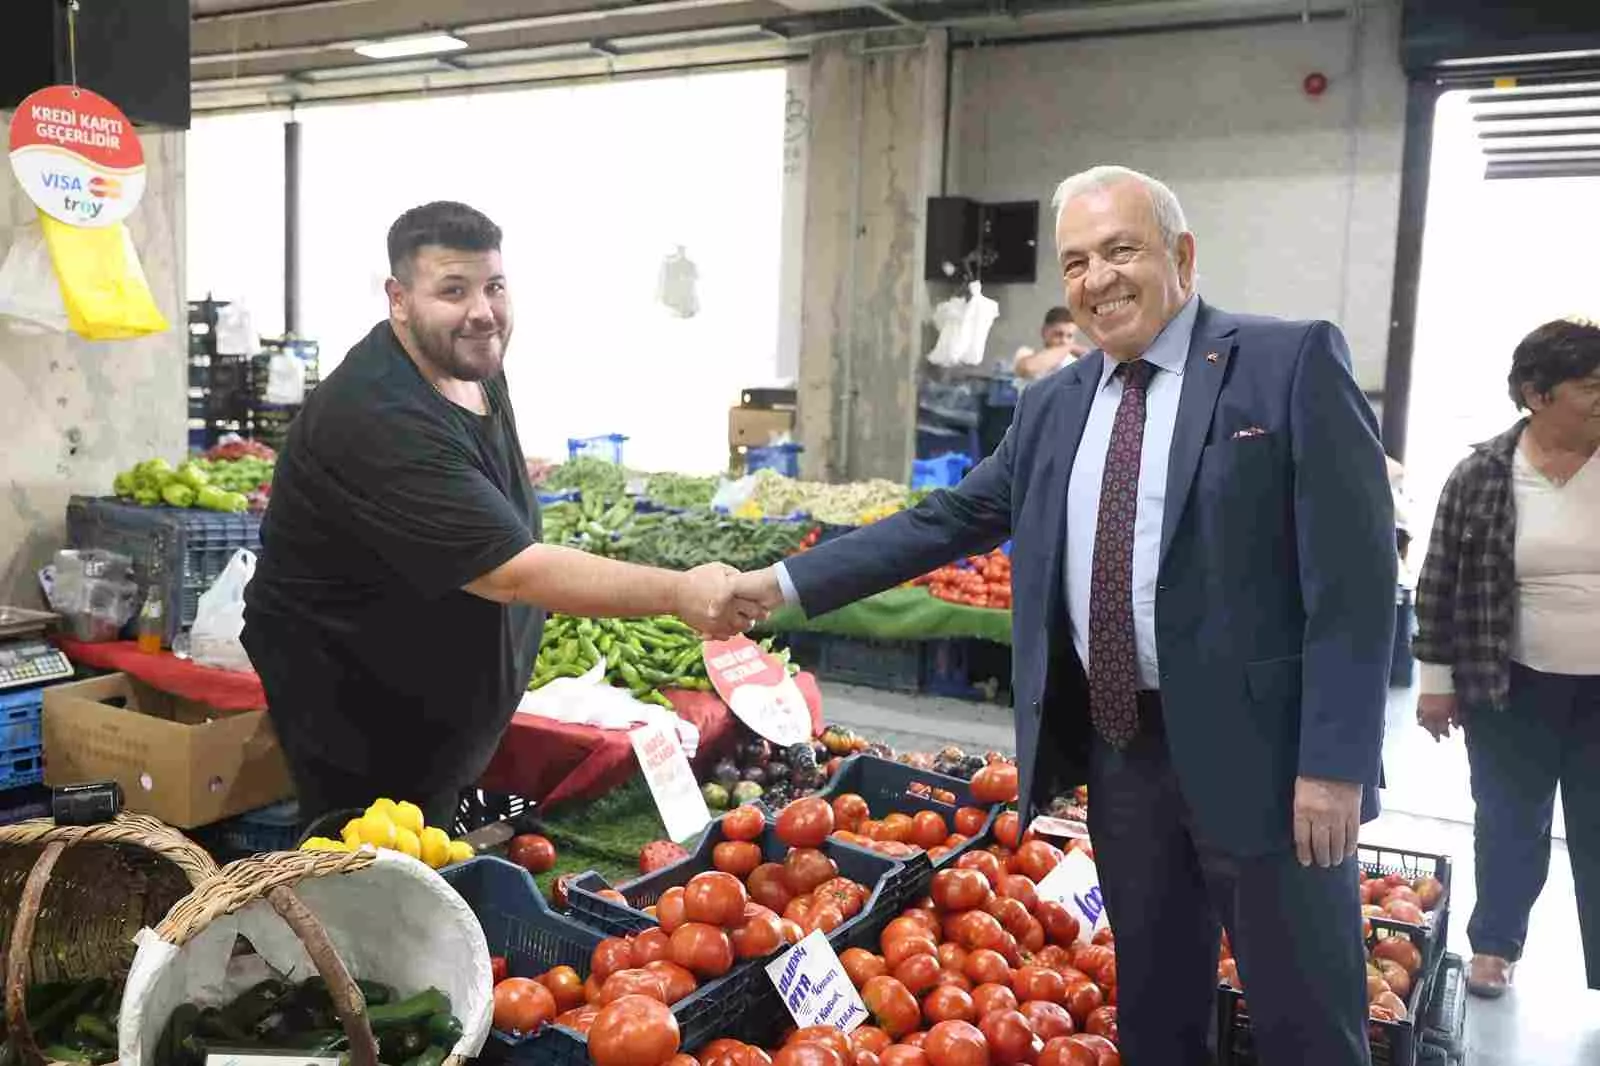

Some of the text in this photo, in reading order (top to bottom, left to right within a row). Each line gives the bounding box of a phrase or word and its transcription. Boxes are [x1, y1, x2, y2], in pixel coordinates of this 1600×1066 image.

[31, 105, 123, 135] KREDİ KARTI
[36, 122, 121, 150] GEÇERLİDİR
[41, 173, 82, 192] VISA
[64, 196, 104, 218] troy
